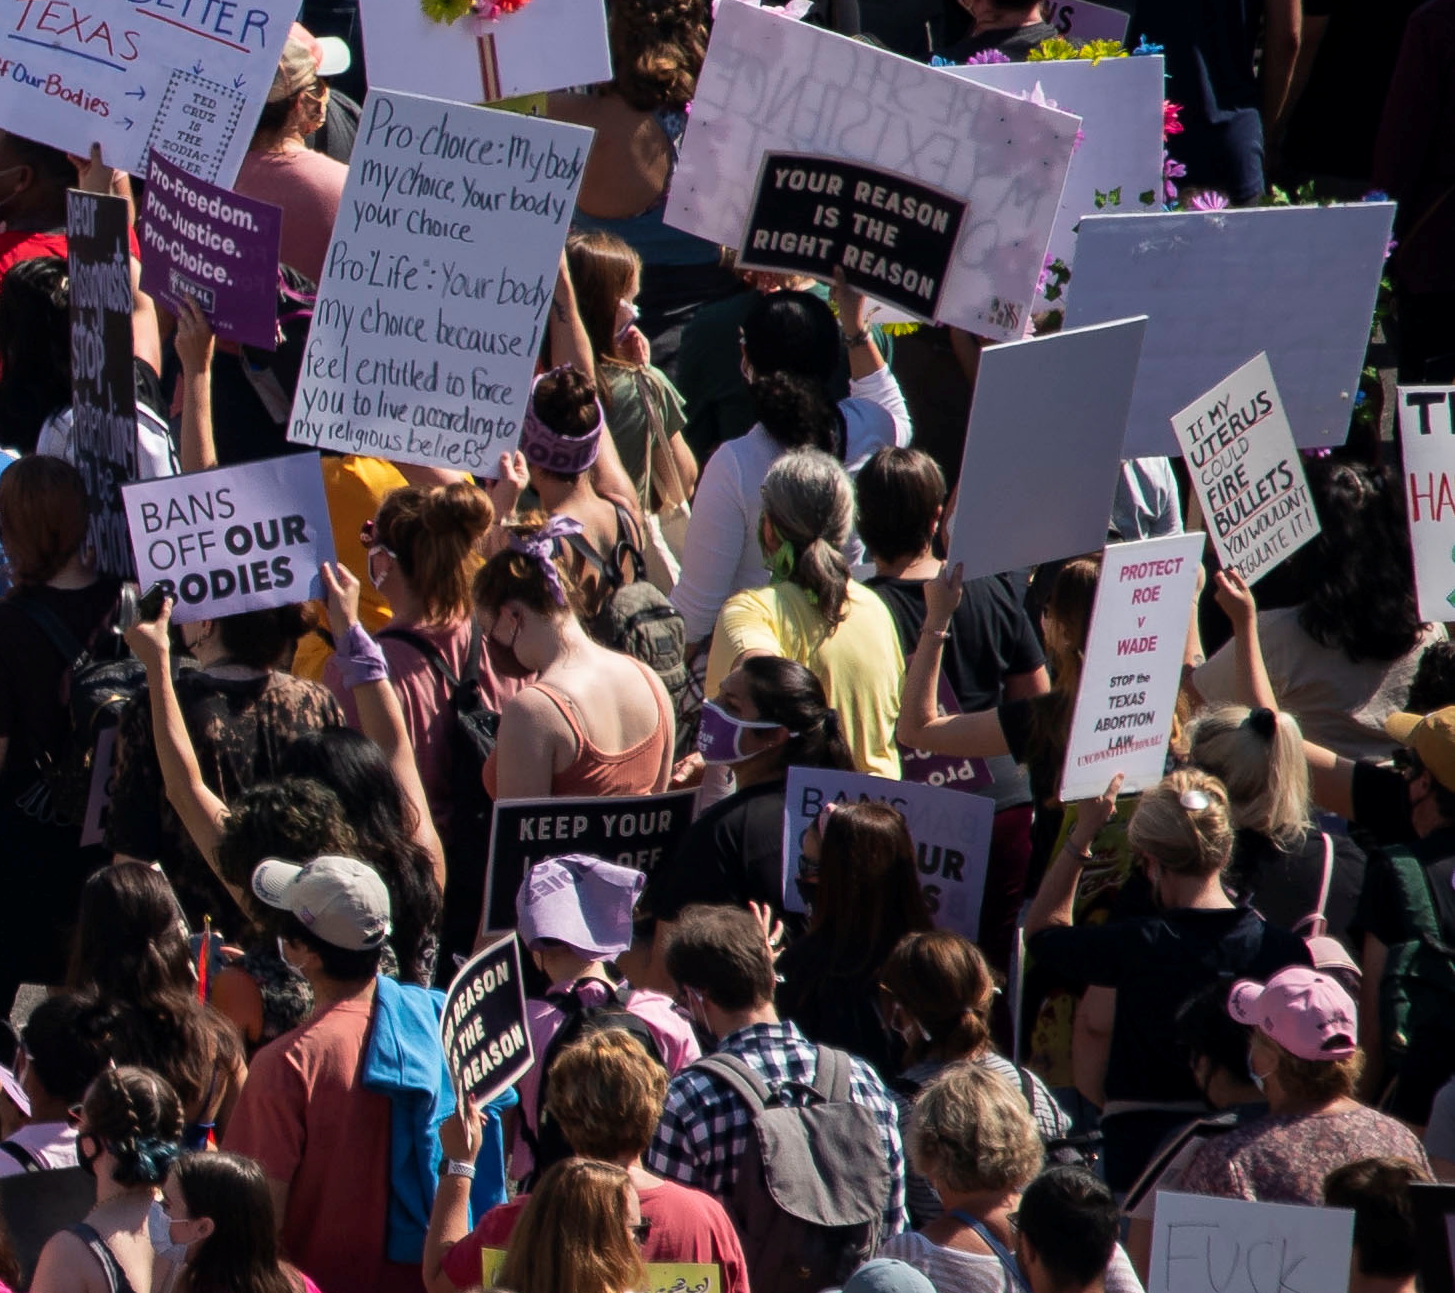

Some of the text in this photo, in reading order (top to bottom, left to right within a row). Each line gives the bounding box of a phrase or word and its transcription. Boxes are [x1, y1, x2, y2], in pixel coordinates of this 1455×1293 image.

[1186, 394, 1231, 444] IF MY
[1190, 390, 1273, 467] UTERUS
[1201, 437, 1249, 486] COULD
[1206, 464, 1250, 510] FIRE
[1214, 461, 1295, 538] BULLETS
[1119, 557, 1184, 583] PROTECT
[1132, 586, 1161, 604] ROE
[1116, 636, 1158, 657] WADE
[1109, 673, 1150, 688] STOP the
[1109, 692, 1145, 709] TEXAS
[1094, 711, 1155, 733] ABORTION
